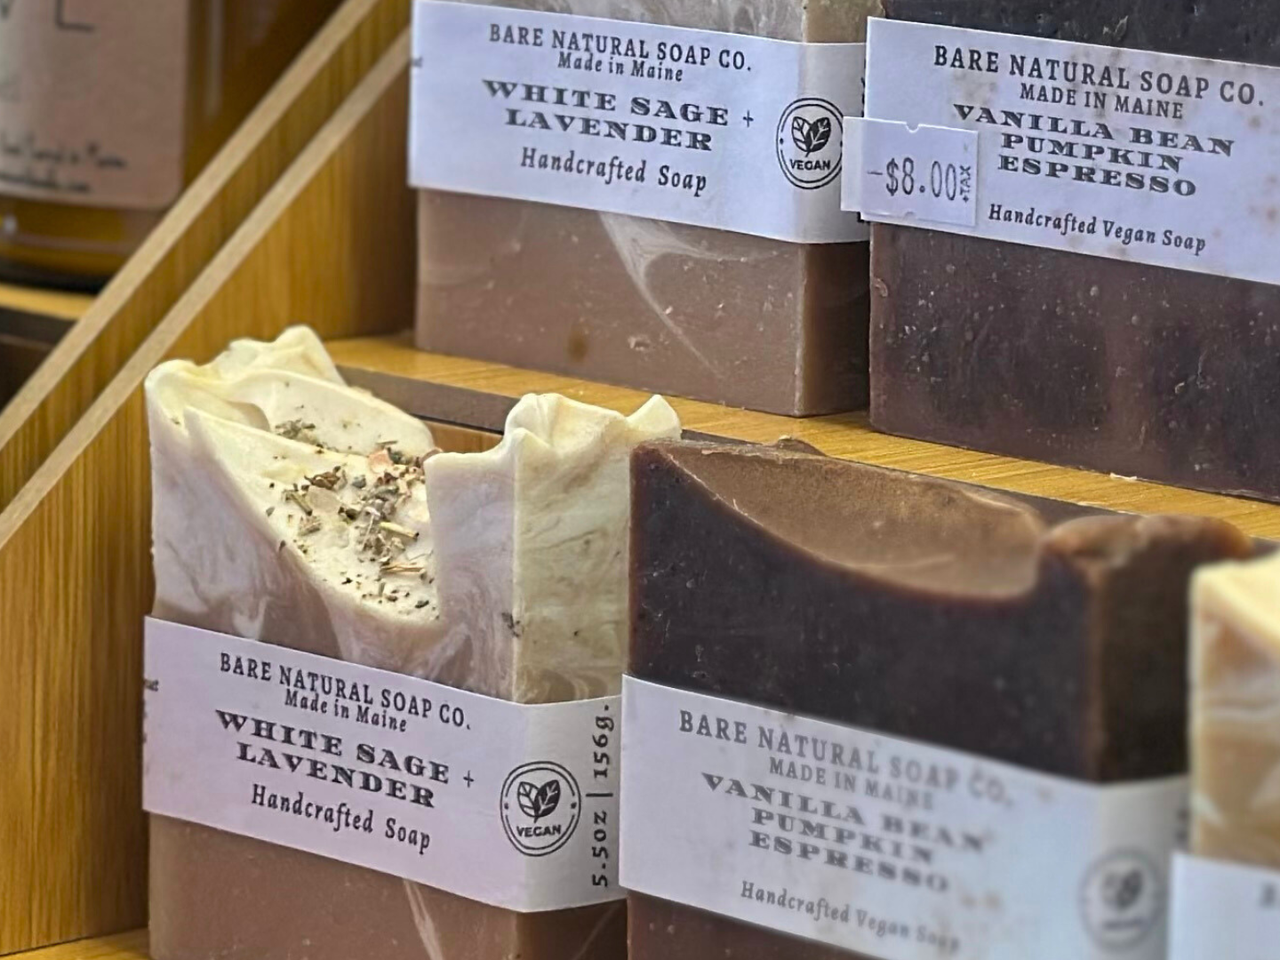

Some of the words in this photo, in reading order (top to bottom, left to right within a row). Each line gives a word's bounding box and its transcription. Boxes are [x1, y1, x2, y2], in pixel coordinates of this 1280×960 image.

[489, 23, 544, 48] BARE
[551, 31, 650, 61] NATURAL
[656, 42, 712, 67] SOAP
[718, 49, 753, 73] CO.
[557, 51, 605, 75] Made
[608, 55, 627, 77] in
[630, 59, 684, 83] Maine
[933, 44, 1000, 75] BARE
[1008, 55, 1131, 92] NATURAL
[1140, 71, 1211, 101] SOAP
[1219, 80, 1266, 108] CO.
[1020, 82, 1078, 108] MADE
[1082, 89, 1107, 110] IN
[1113, 93, 1185, 121] MAINE
[481, 79, 618, 113] WHITE
[629, 97, 730, 128] SAGE
[742, 111, 755, 129] +
[504, 108, 714, 153] LAVENDER
[953, 103, 1114, 141] VANILLA
[1128, 126, 1236, 158] BEAN
[519, 146, 647, 186] Handcrafted
[657, 165, 709, 198] Soap
[789, 158, 833, 172] VEGAN
[997, 154, 1198, 197] ESPRESSO
[1001, 132, 1185, 175] PUMPKIN
[988, 203, 1099, 237] Handcrafted
[1102, 219, 1157, 247] Vegan
[1162, 229, 1208, 256] Soap
[220, 652, 272, 681] BARE
[279, 665, 375, 706] NATURAL
[381, 688, 433, 719] SOAP
[439, 702, 471, 731] CO.
[285, 689, 329, 715] Made
[333, 697, 351, 719] in
[356, 704, 408, 733] Maine
[215, 708, 343, 758] WHITE
[355, 742, 451, 784] SAGE
[462, 770, 475, 789] +
[593, 704, 615, 780] 156g.
[679, 709, 749, 746] BARE
[758, 725, 881, 775] NATURAL
[889, 754, 961, 792] SOAP
[967, 773, 1014, 810] CO.
[236, 741, 436, 809] LAVENDER
[769, 757, 829, 787] MADE
[835, 769, 858, 795] IN
[865, 777, 936, 812] MAINE
[252, 783, 375, 835] Handcrafted
[384, 817, 432, 856] Soap
[516, 824, 562, 838] VEGAN
[701, 771, 867, 828] VANILLA
[880, 812, 988, 854] BEAN
[751, 806, 936, 866] PUMPKIN
[592, 810, 610, 889] 5.5oz
[749, 830, 952, 895] ESPRESSO
[740, 879, 851, 926] Handcrafted
[856, 907, 911, 943] Vegan
